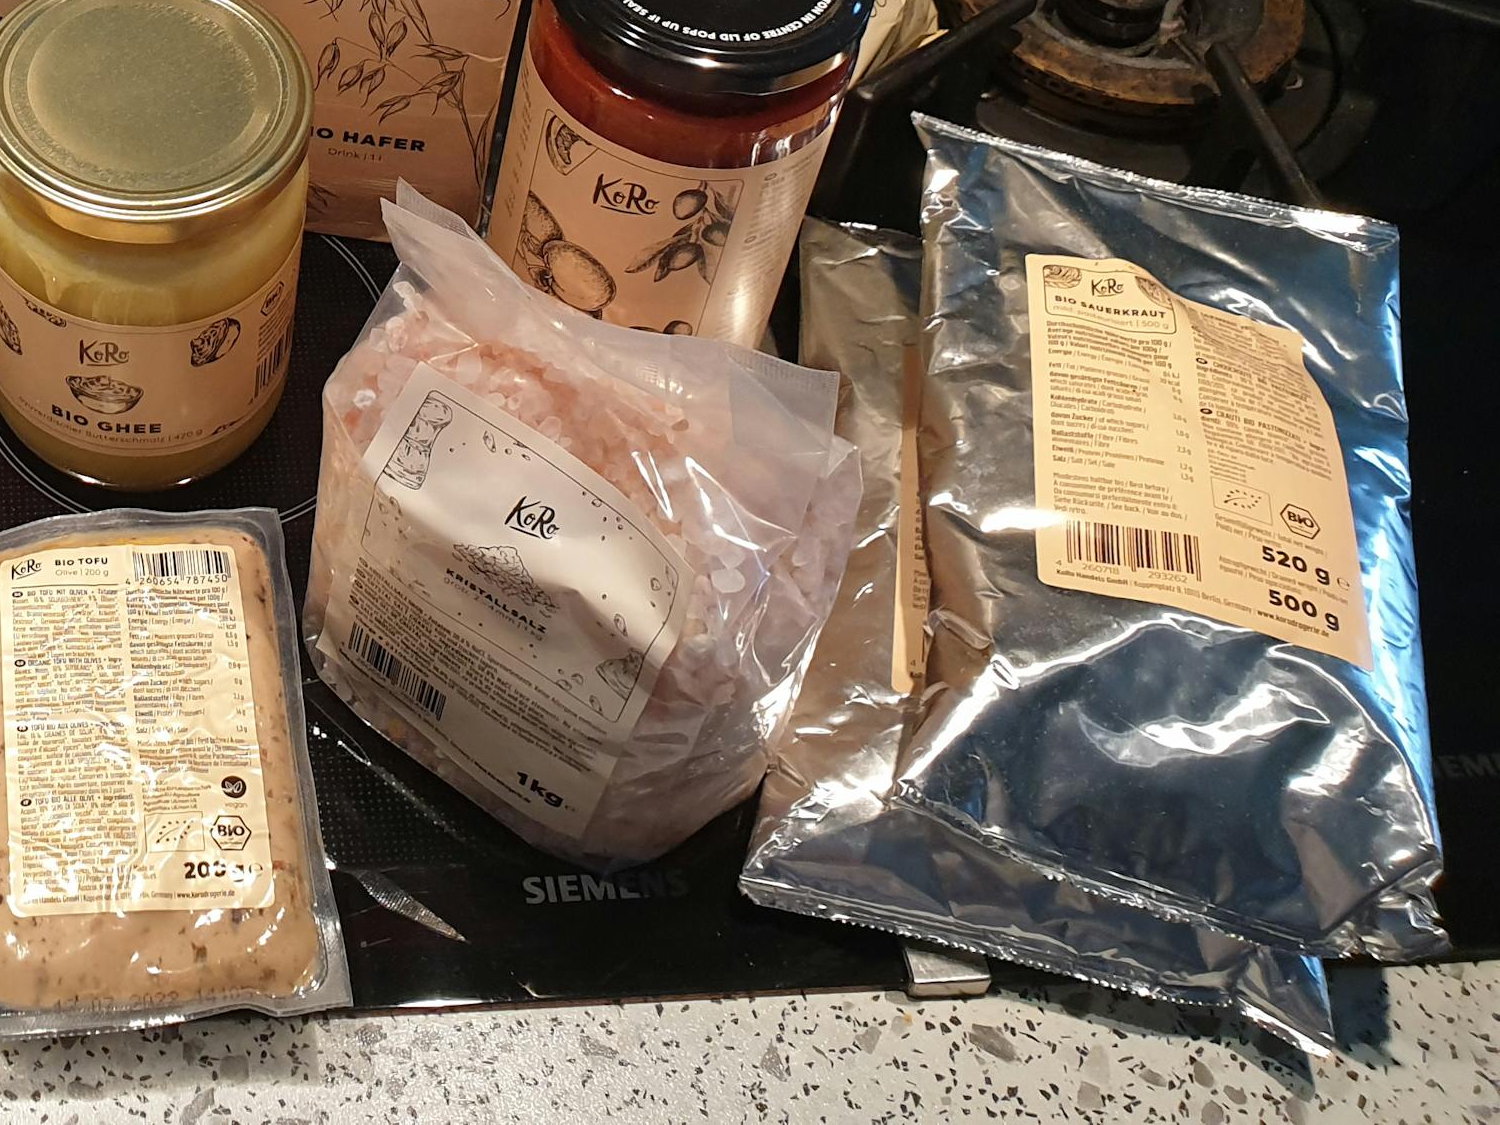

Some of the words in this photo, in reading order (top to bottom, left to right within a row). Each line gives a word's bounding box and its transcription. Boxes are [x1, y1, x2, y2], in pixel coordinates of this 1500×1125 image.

[647, 13, 661, 23] IF
[661, 20, 680, 31] UP
[800, 12, 816, 24] IN
[682, 26, 717, 40] POPS
[719, 33, 740, 41] LID
[743, 32, 761, 41] OF
[761, 20, 804, 39] CENTRE
[343, 128, 426, 153] HAFER
[328, 148, 359, 159] Drink
[593, 173, 660, 216] KoRo
[1091, 278, 1125, 297] KoRo
[1054, 295, 1077, 304] BIO
[1081, 301, 1167, 319] SAUERKRAUT
[1142, 320, 1160, 328] 500
[79, 338, 130, 366] KoRo
[51, 404, 88, 426] BIO
[97, 421, 162, 433] GHEE
[504, 495, 560, 539] KoRo
[1287, 510, 1314, 528] BIO
[11, 559, 42, 580] KoRo
[78, 557, 108, 565] TOFU
[1262, 545, 1308, 572] 520
[1315, 567, 1330, 586] g
[125, 577, 131, 585] 4
[139, 576, 180, 586] 260654
[186, 574, 228, 585] 787450
[1082, 563, 1120, 575] 260718
[1148, 571, 1187, 584] 293262
[446, 567, 547, 634] KRISTALLSALZ
[1268, 589, 1317, 618] 500
[1325, 611, 1340, 632] g
[516, 771, 528, 789] 1
[529, 778, 565, 809] kg
[217, 824, 245, 837] BIO
